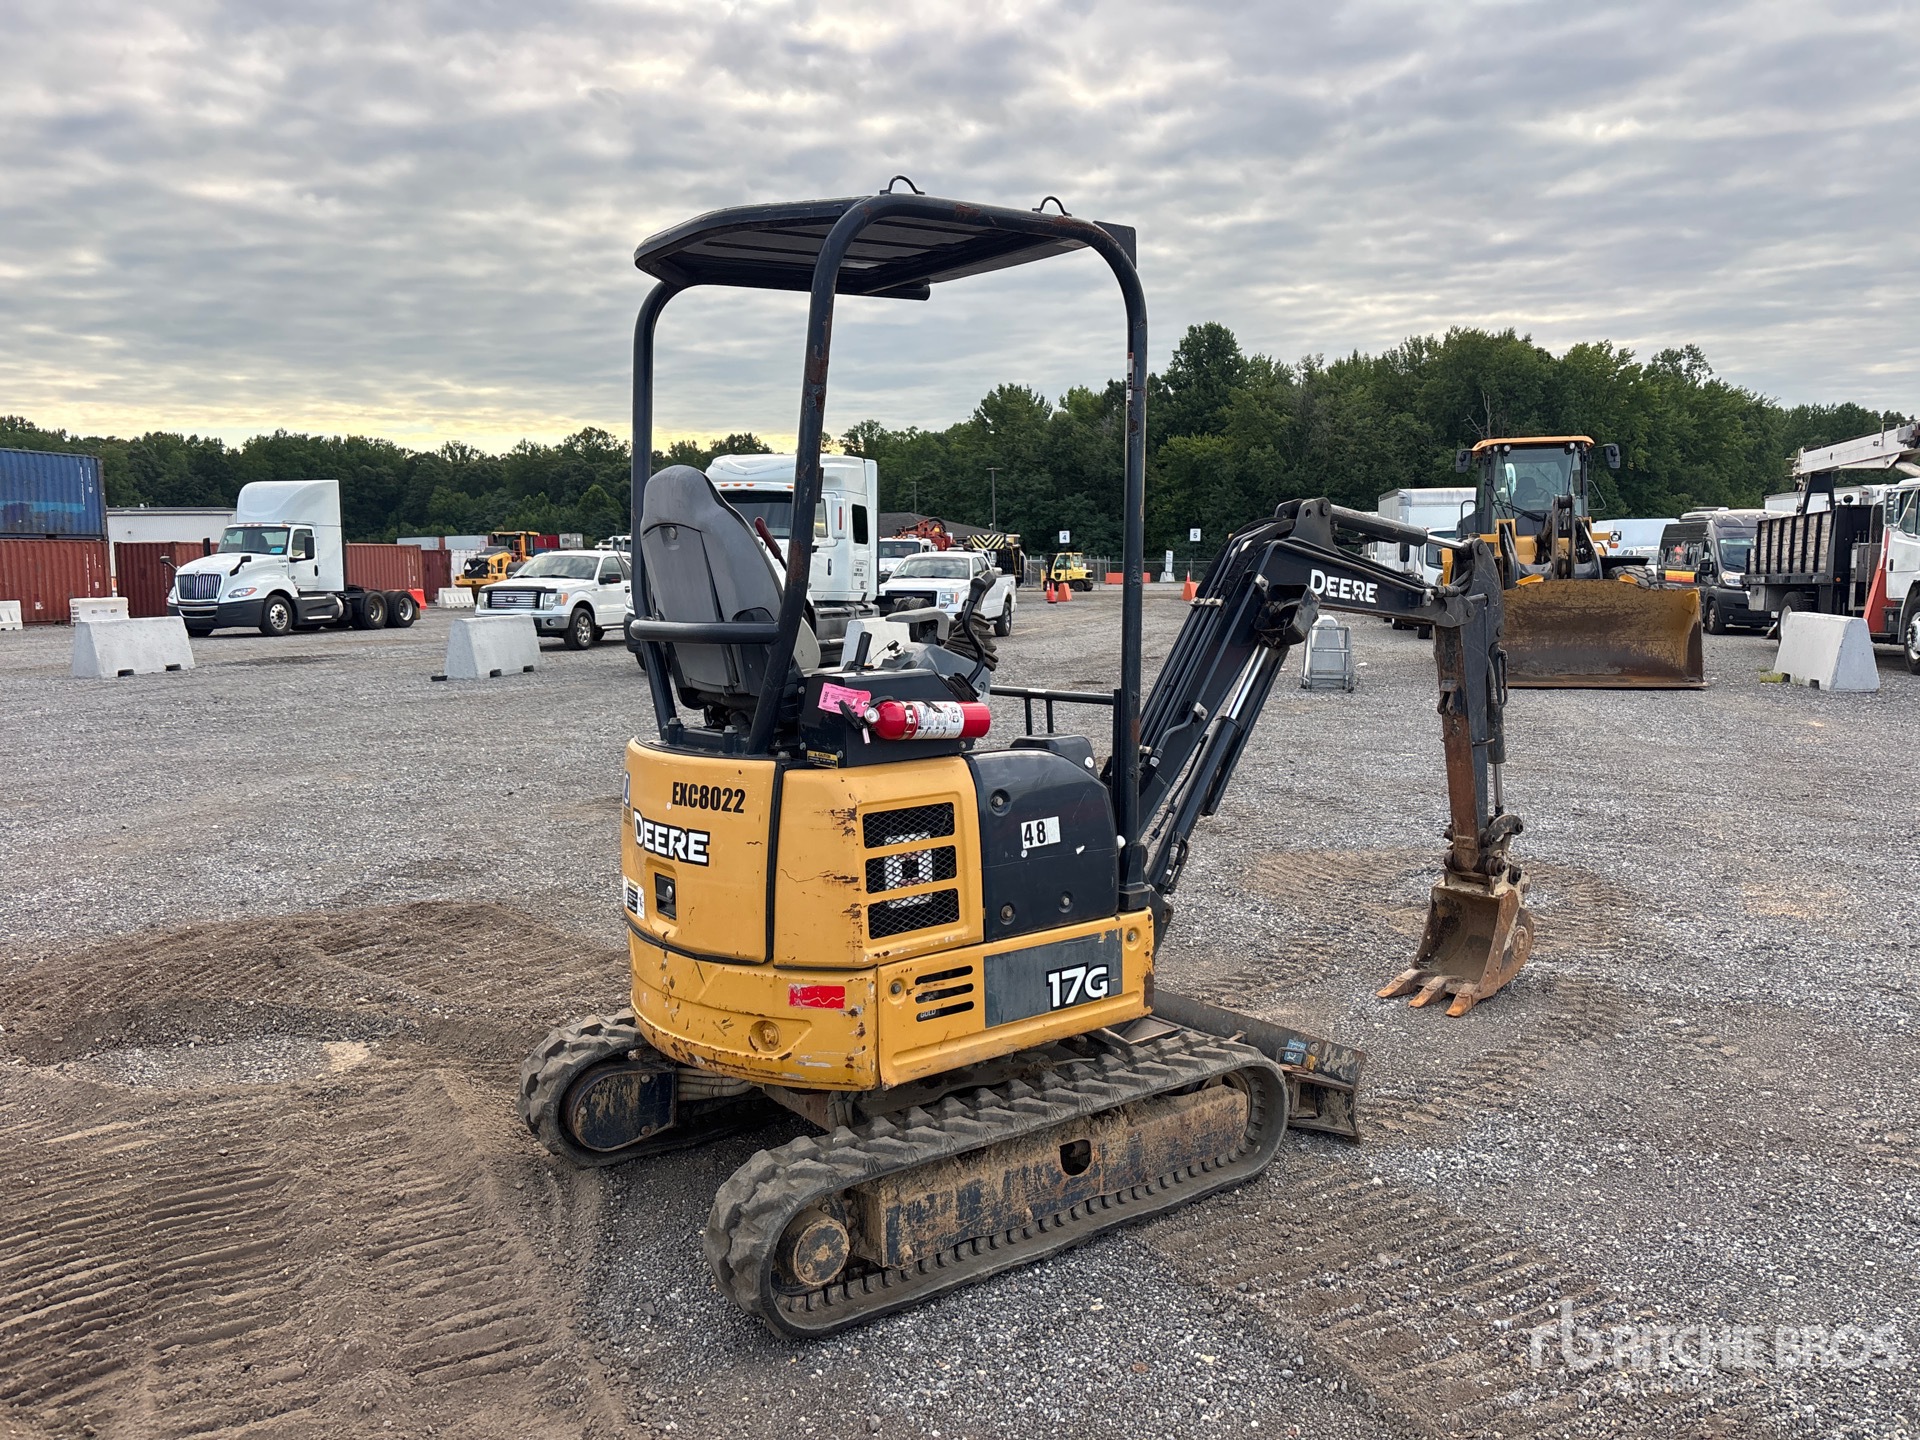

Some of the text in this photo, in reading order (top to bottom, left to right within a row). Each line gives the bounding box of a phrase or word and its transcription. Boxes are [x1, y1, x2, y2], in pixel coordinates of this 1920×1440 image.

[1310, 568, 1378, 604] DEERE
[672, 781, 746, 814] EXC8022
[633, 808, 710, 866] DEERE
[1024, 820, 1047, 846] 48
[1047, 963, 1110, 1010] 17G
